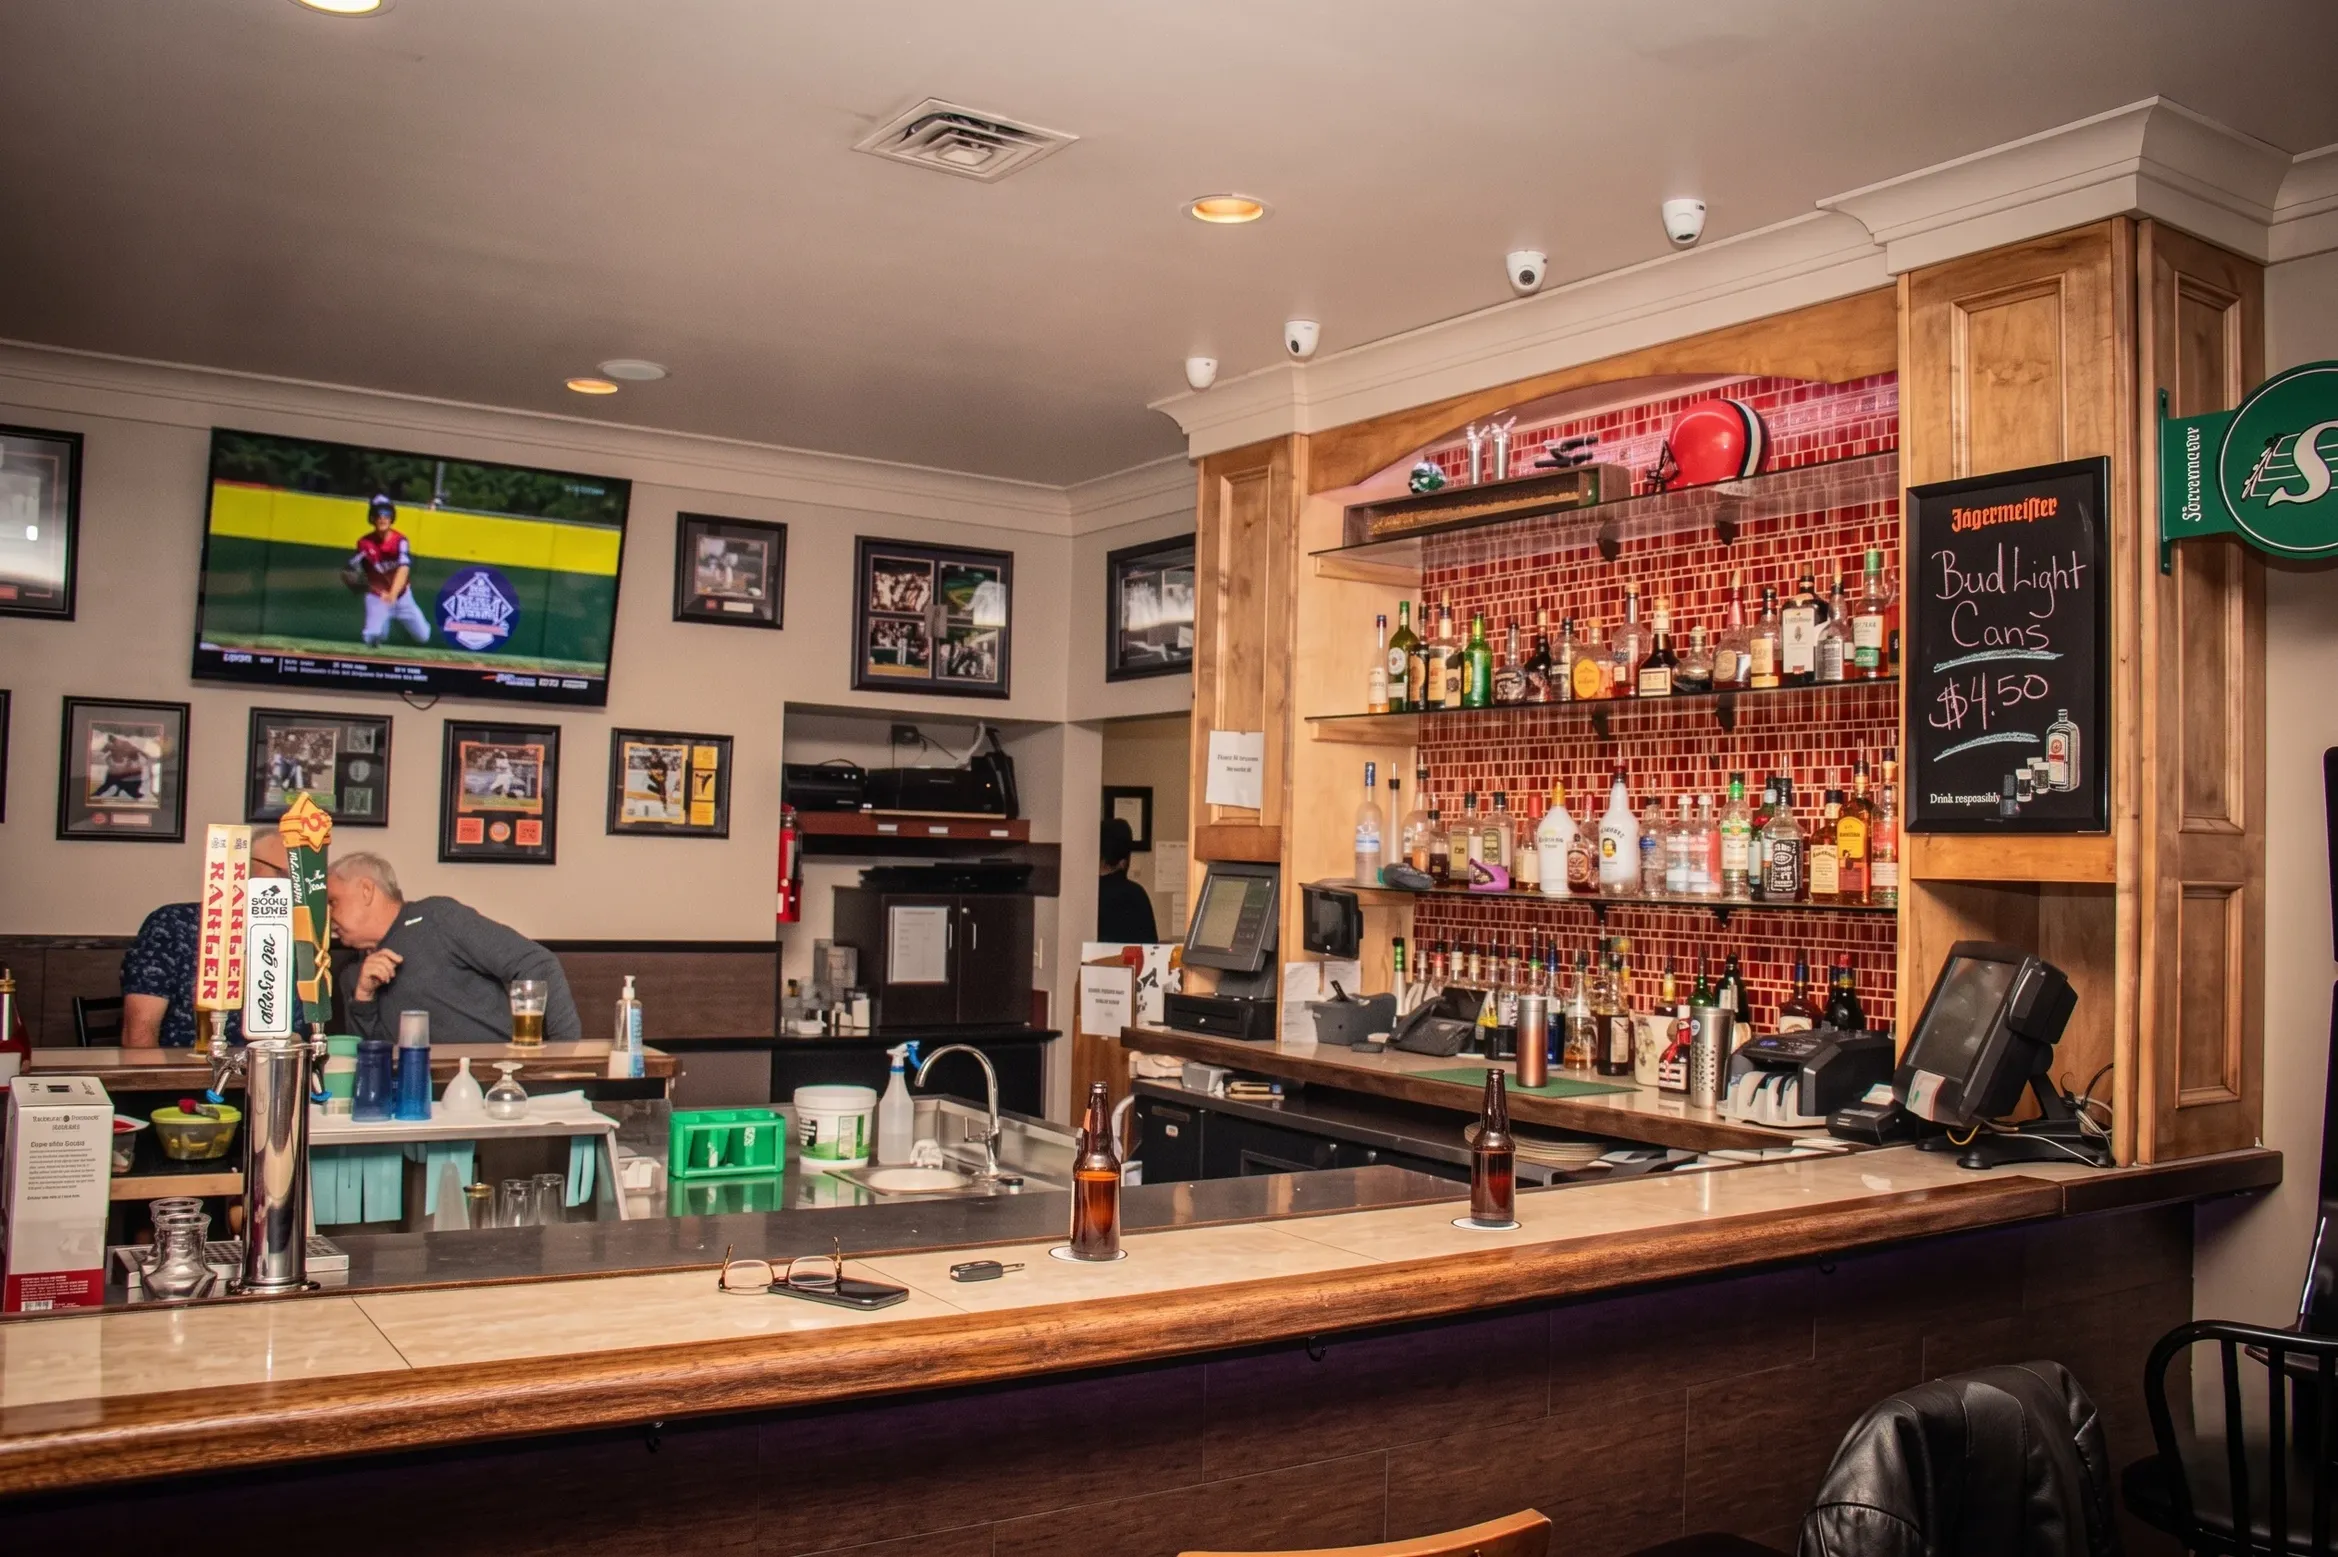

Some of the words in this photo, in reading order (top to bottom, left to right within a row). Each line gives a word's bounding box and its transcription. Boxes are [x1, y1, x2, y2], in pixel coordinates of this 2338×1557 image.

[1930, 542, 2007, 600] Bud
[2013, 546, 2087, 619] Light
[1951, 600, 2050, 651] Cans
[1928, 672, 2048, 731] $4.50
[1930, 793, 1953, 804] Drink
